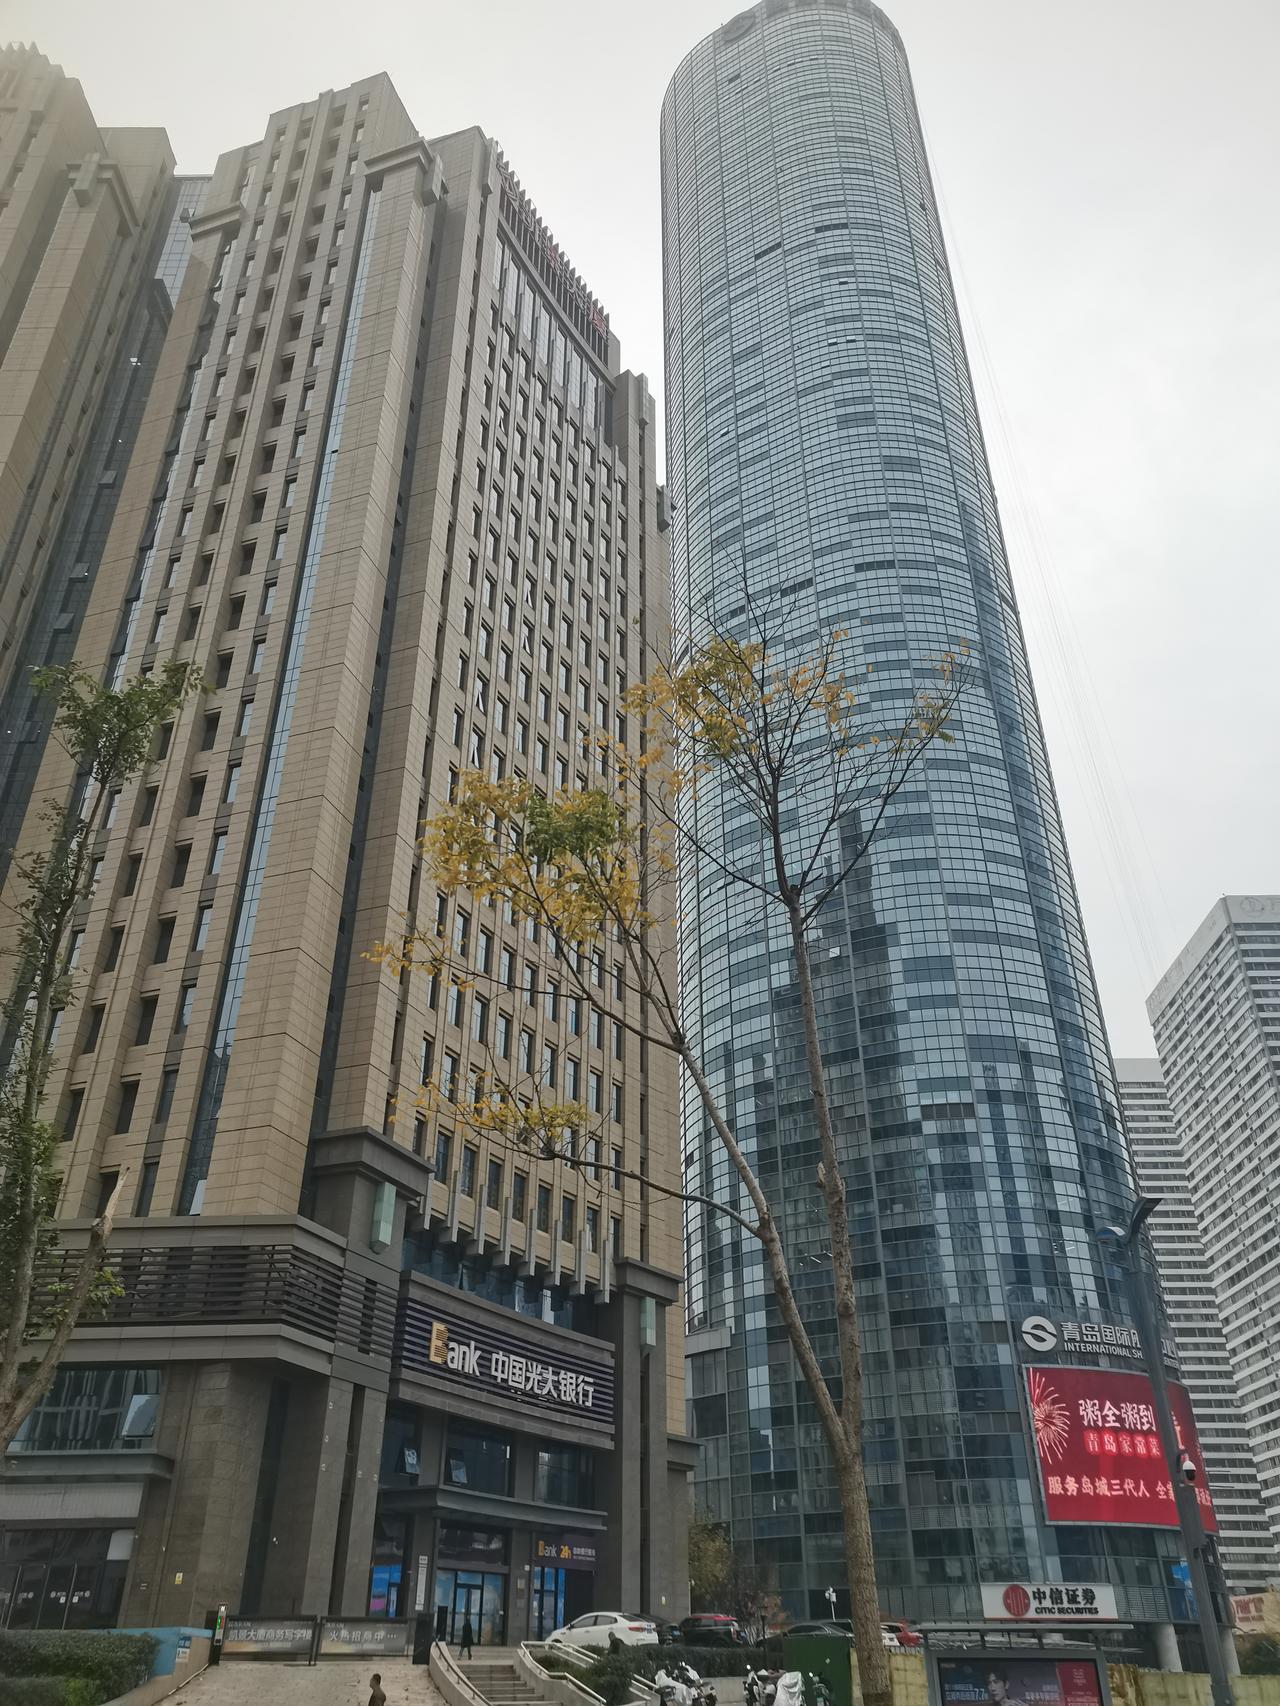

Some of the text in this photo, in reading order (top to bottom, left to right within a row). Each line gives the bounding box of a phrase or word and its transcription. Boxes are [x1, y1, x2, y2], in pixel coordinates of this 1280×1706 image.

[1064, 1342, 1132, 1358] INTERNATIONAL
[428, 1321, 595, 1408] Bank 中国光大银行
[1078, 1399, 1157, 1432] 粥全粥到
[1048, 1474, 1151, 1498] 服务岛城三代人
[1032, 1587, 1097, 1607] 中信证券
[1035, 1606, 1100, 1616] CITIC SECURITIES
